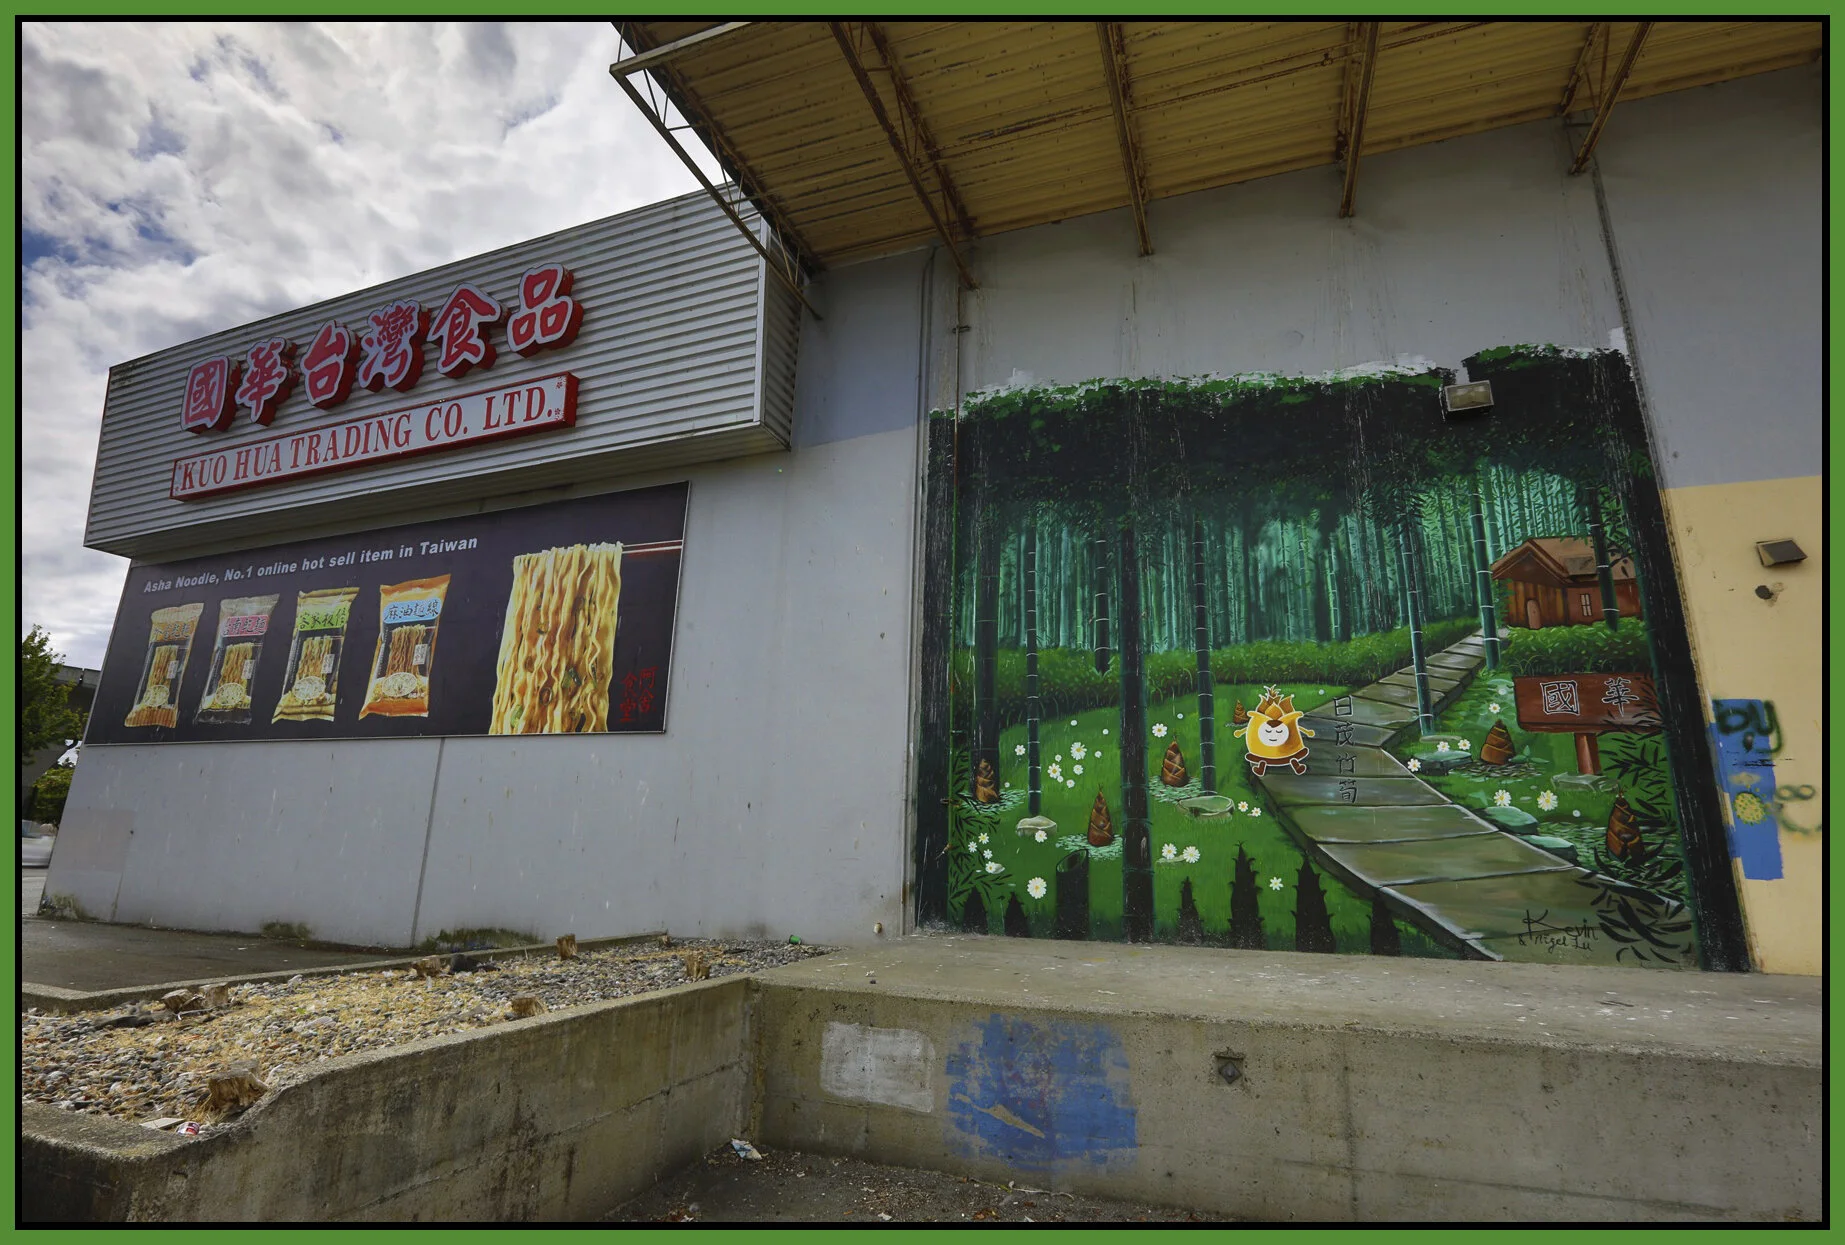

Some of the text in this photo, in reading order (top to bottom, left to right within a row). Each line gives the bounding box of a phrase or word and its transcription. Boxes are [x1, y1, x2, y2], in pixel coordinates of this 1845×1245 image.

[181, 263, 575, 430] 國華台灣食品
[180, 386, 553, 491] KUO HUA TRADING CO. LTD.
[144, 537, 478, 593] Asha Noodle, No.1 online hot sell item in Taiwan
